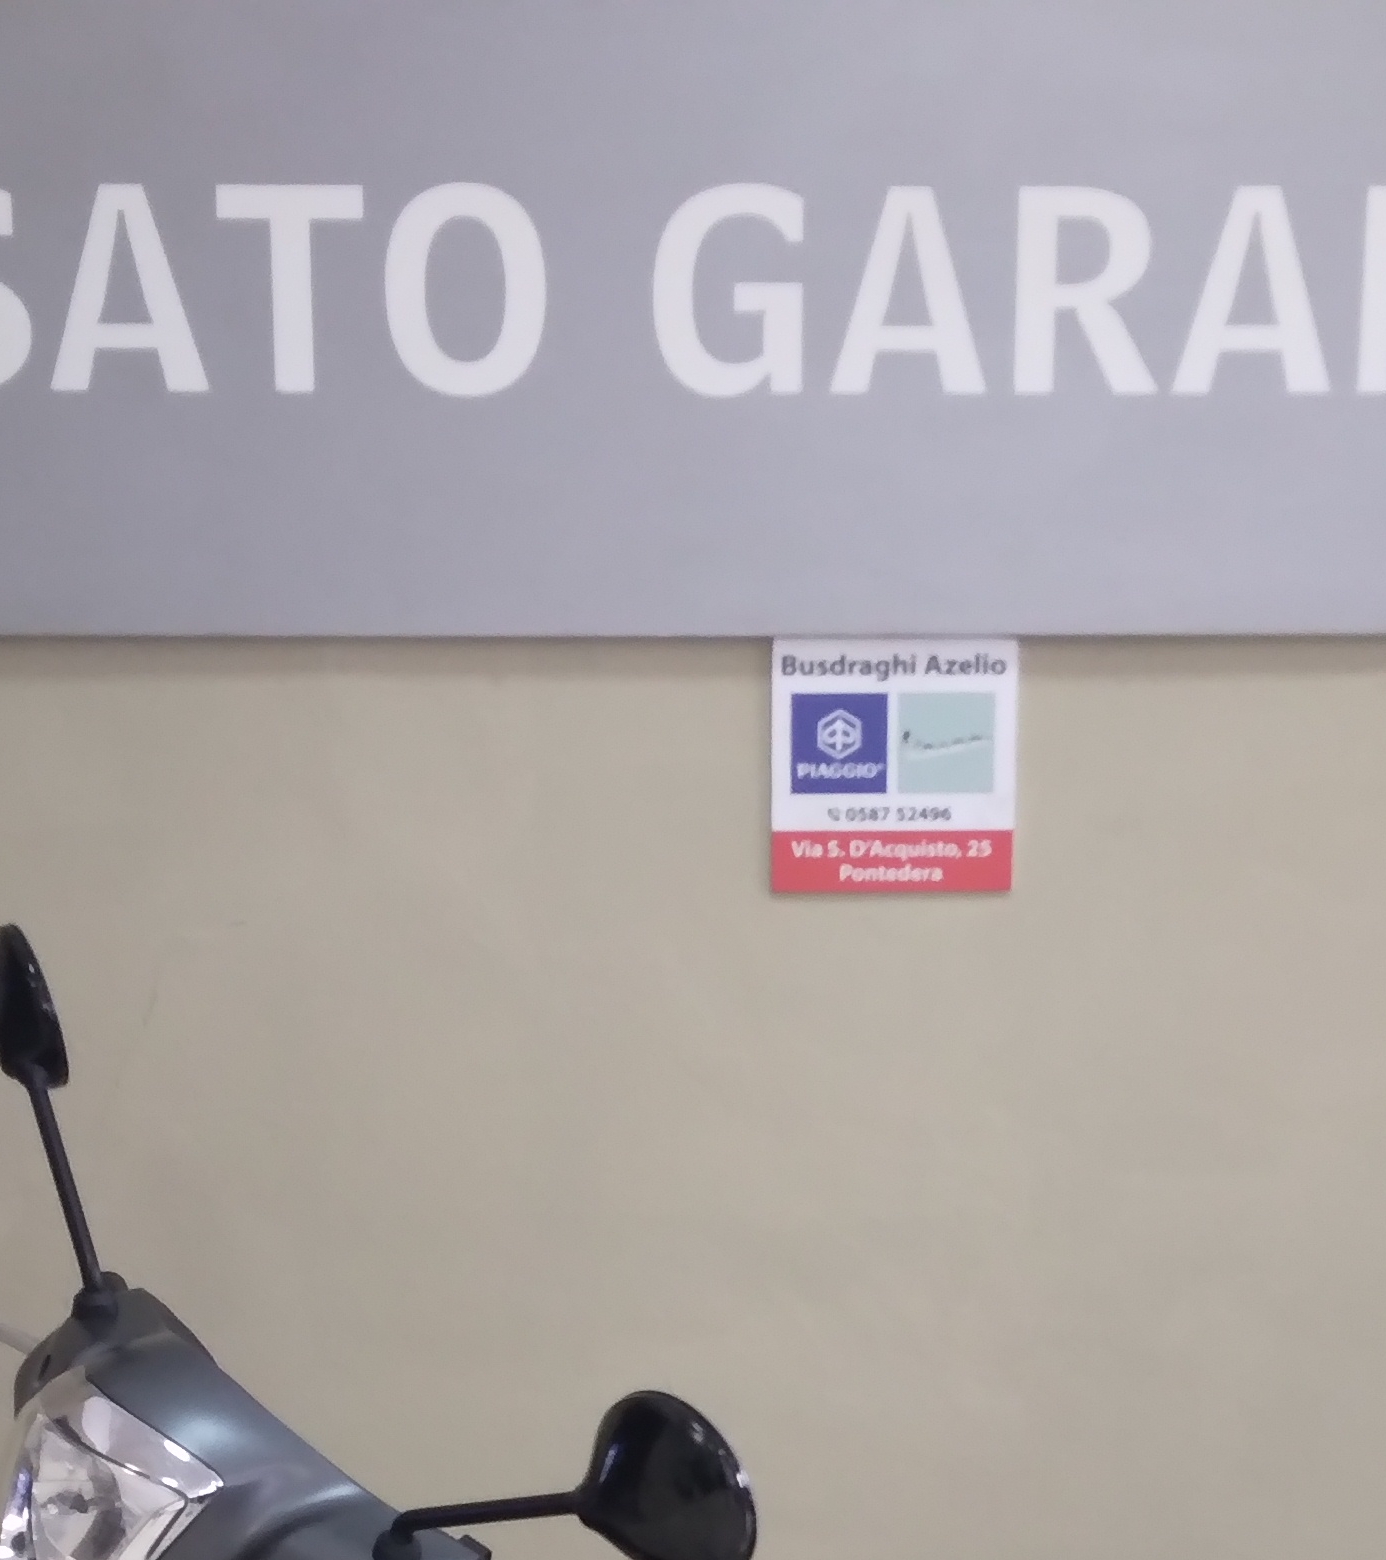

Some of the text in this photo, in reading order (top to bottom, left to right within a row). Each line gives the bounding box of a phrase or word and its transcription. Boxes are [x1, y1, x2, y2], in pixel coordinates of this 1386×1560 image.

[781, 653, 1008, 681] Busdraghi Azelio
[845, 806, 890, 822] 0587
[791, 839, 823, 858] Via
[827, 839, 845, 858] S.
[839, 863, 944, 882] Pontedera
